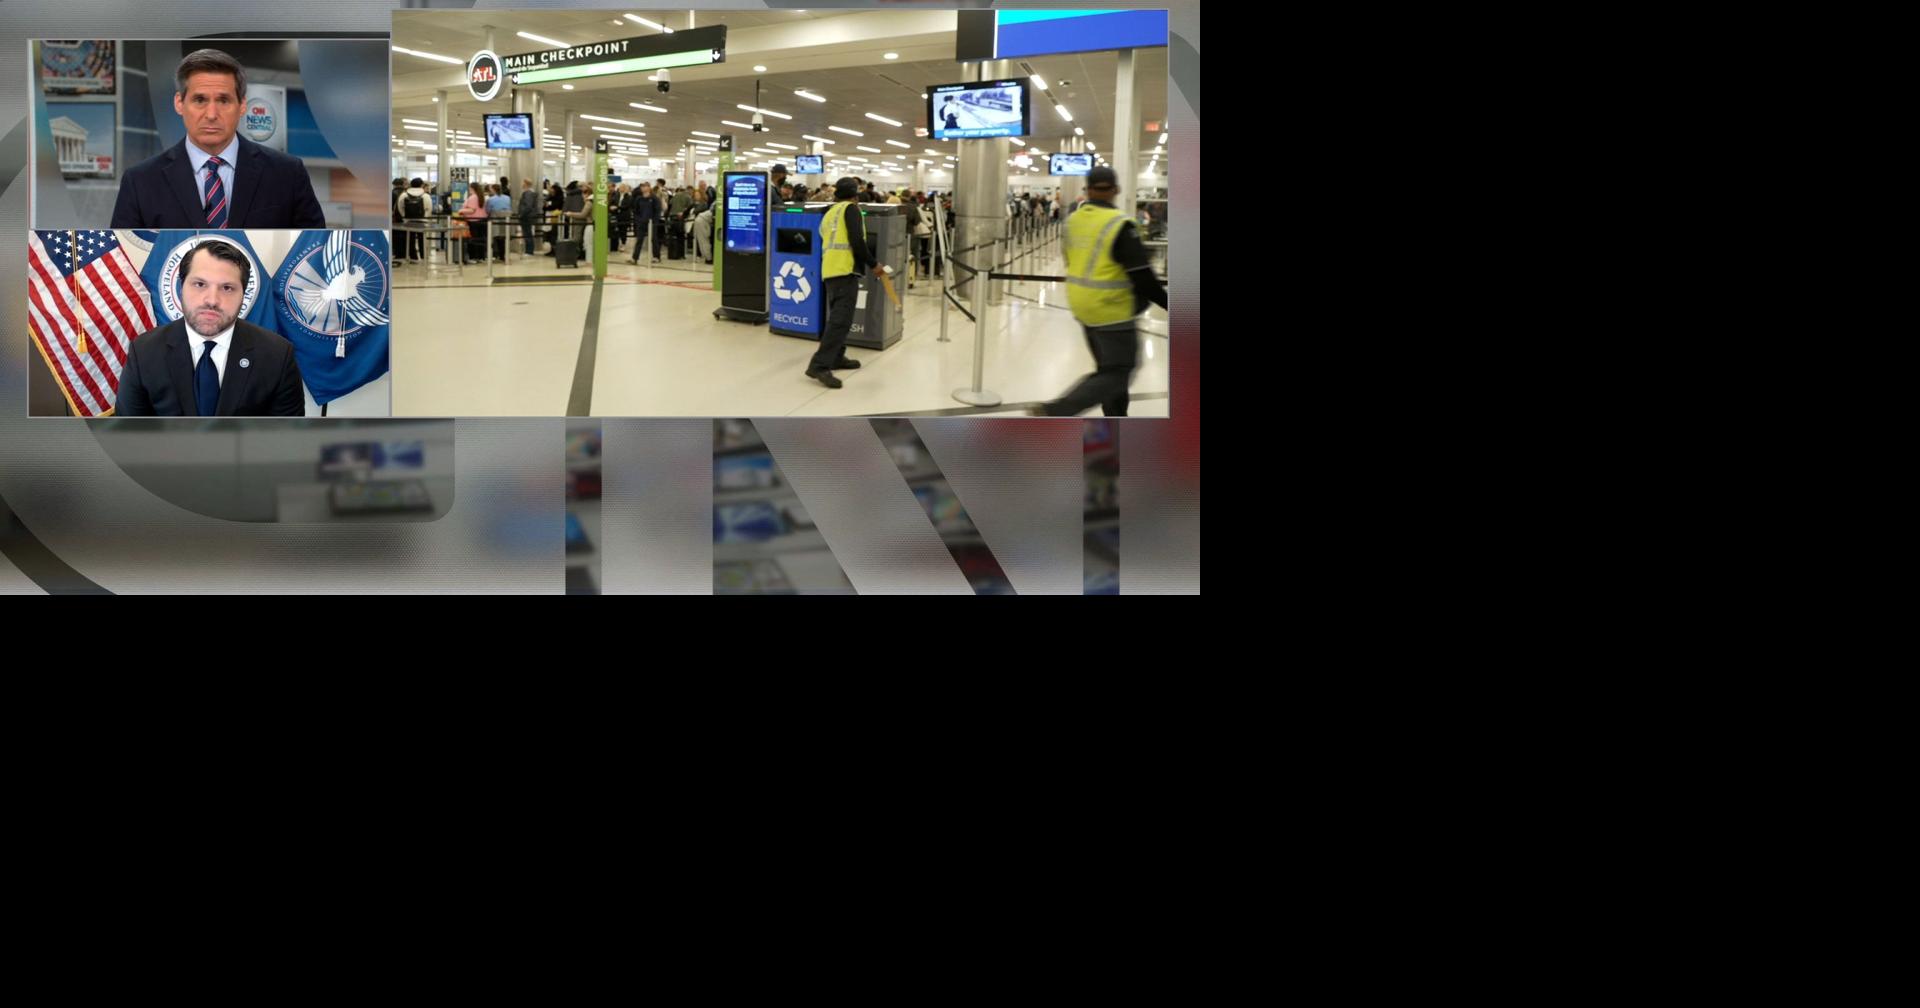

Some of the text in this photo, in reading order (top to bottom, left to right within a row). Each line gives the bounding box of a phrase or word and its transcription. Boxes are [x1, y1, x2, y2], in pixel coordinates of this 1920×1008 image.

[505, 40, 630, 68] MAIN CHECKPOINT
[472, 65, 497, 83] ATL
[252, 107, 266, 115] CNN
[246, 115, 273, 125] NEWS
[163, 252, 182, 311] HOMELAND
[773, 312, 809, 326] RECYCLE
[849, 323, 865, 333] SH
[299, 329, 363, 341] ADMINISTRTION
